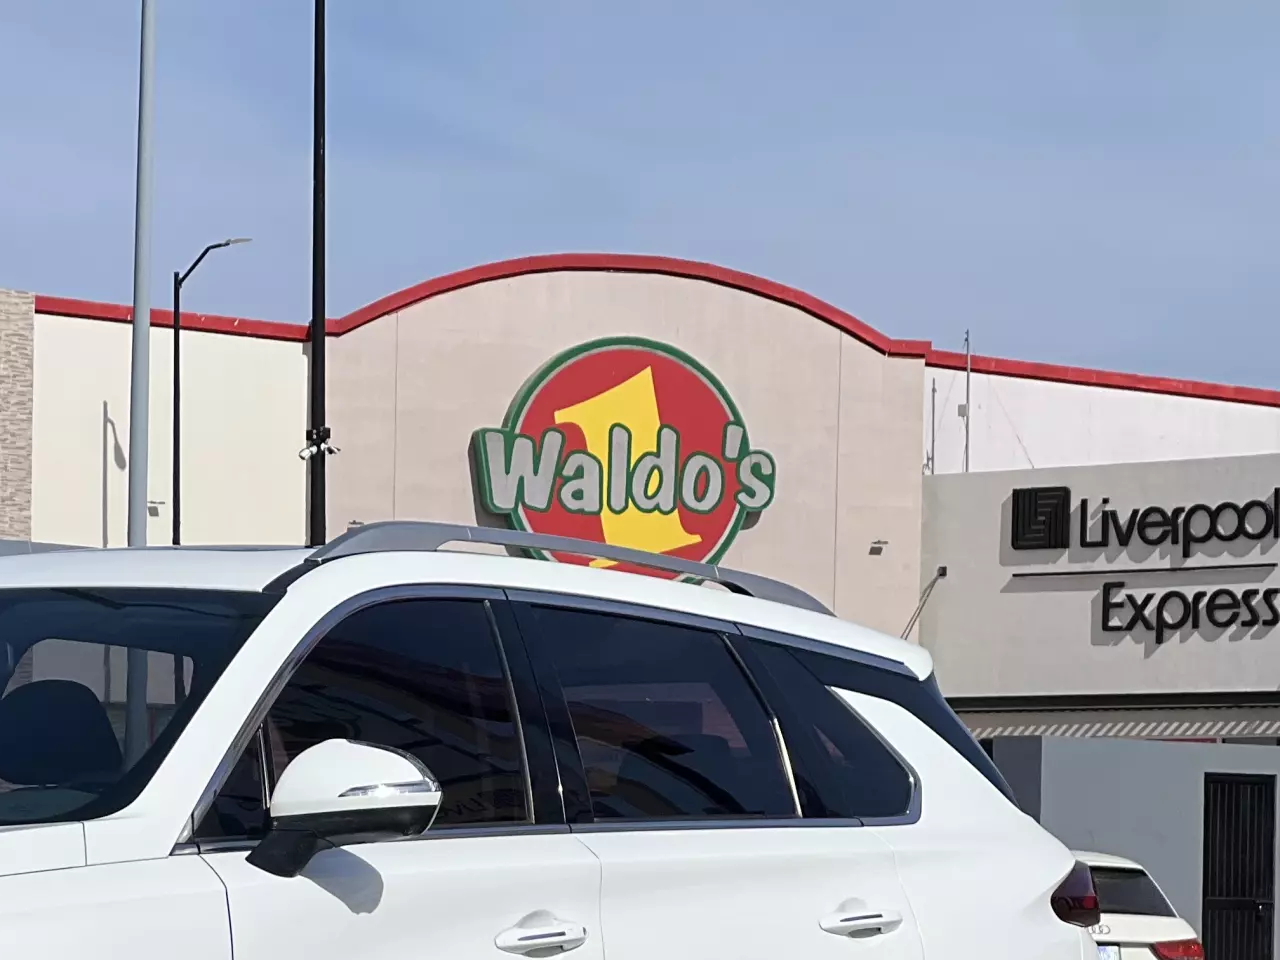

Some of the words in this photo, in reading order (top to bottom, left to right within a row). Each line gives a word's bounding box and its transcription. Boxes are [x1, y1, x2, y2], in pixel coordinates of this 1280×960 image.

[484, 423, 775, 513] Waldo's
[1080, 487, 1280, 558] Liverpool
[1102, 582, 1280, 644] Express
